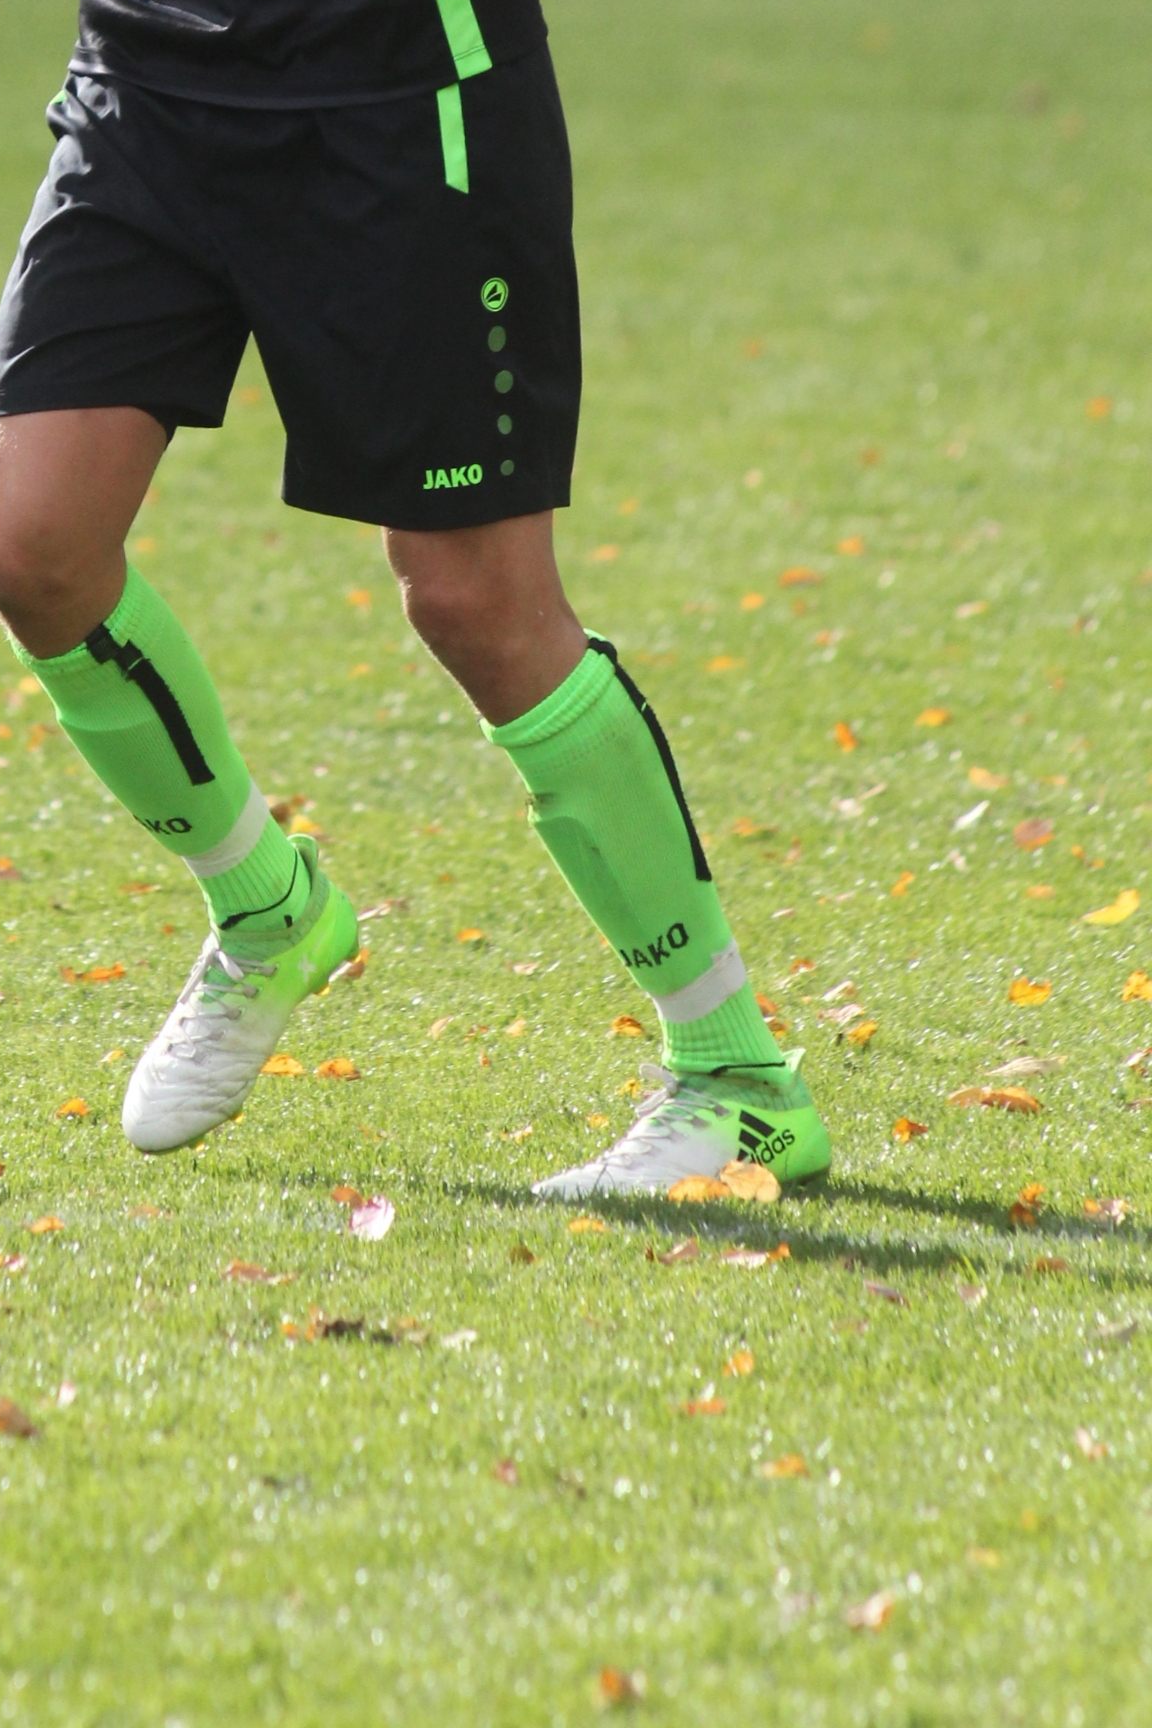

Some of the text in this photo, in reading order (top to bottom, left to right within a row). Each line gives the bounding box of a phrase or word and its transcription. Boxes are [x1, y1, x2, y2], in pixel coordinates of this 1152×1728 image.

[423, 463, 483, 490] JAKO
[133, 813, 192, 835] KO
[750, 1128, 795, 1167] idas
